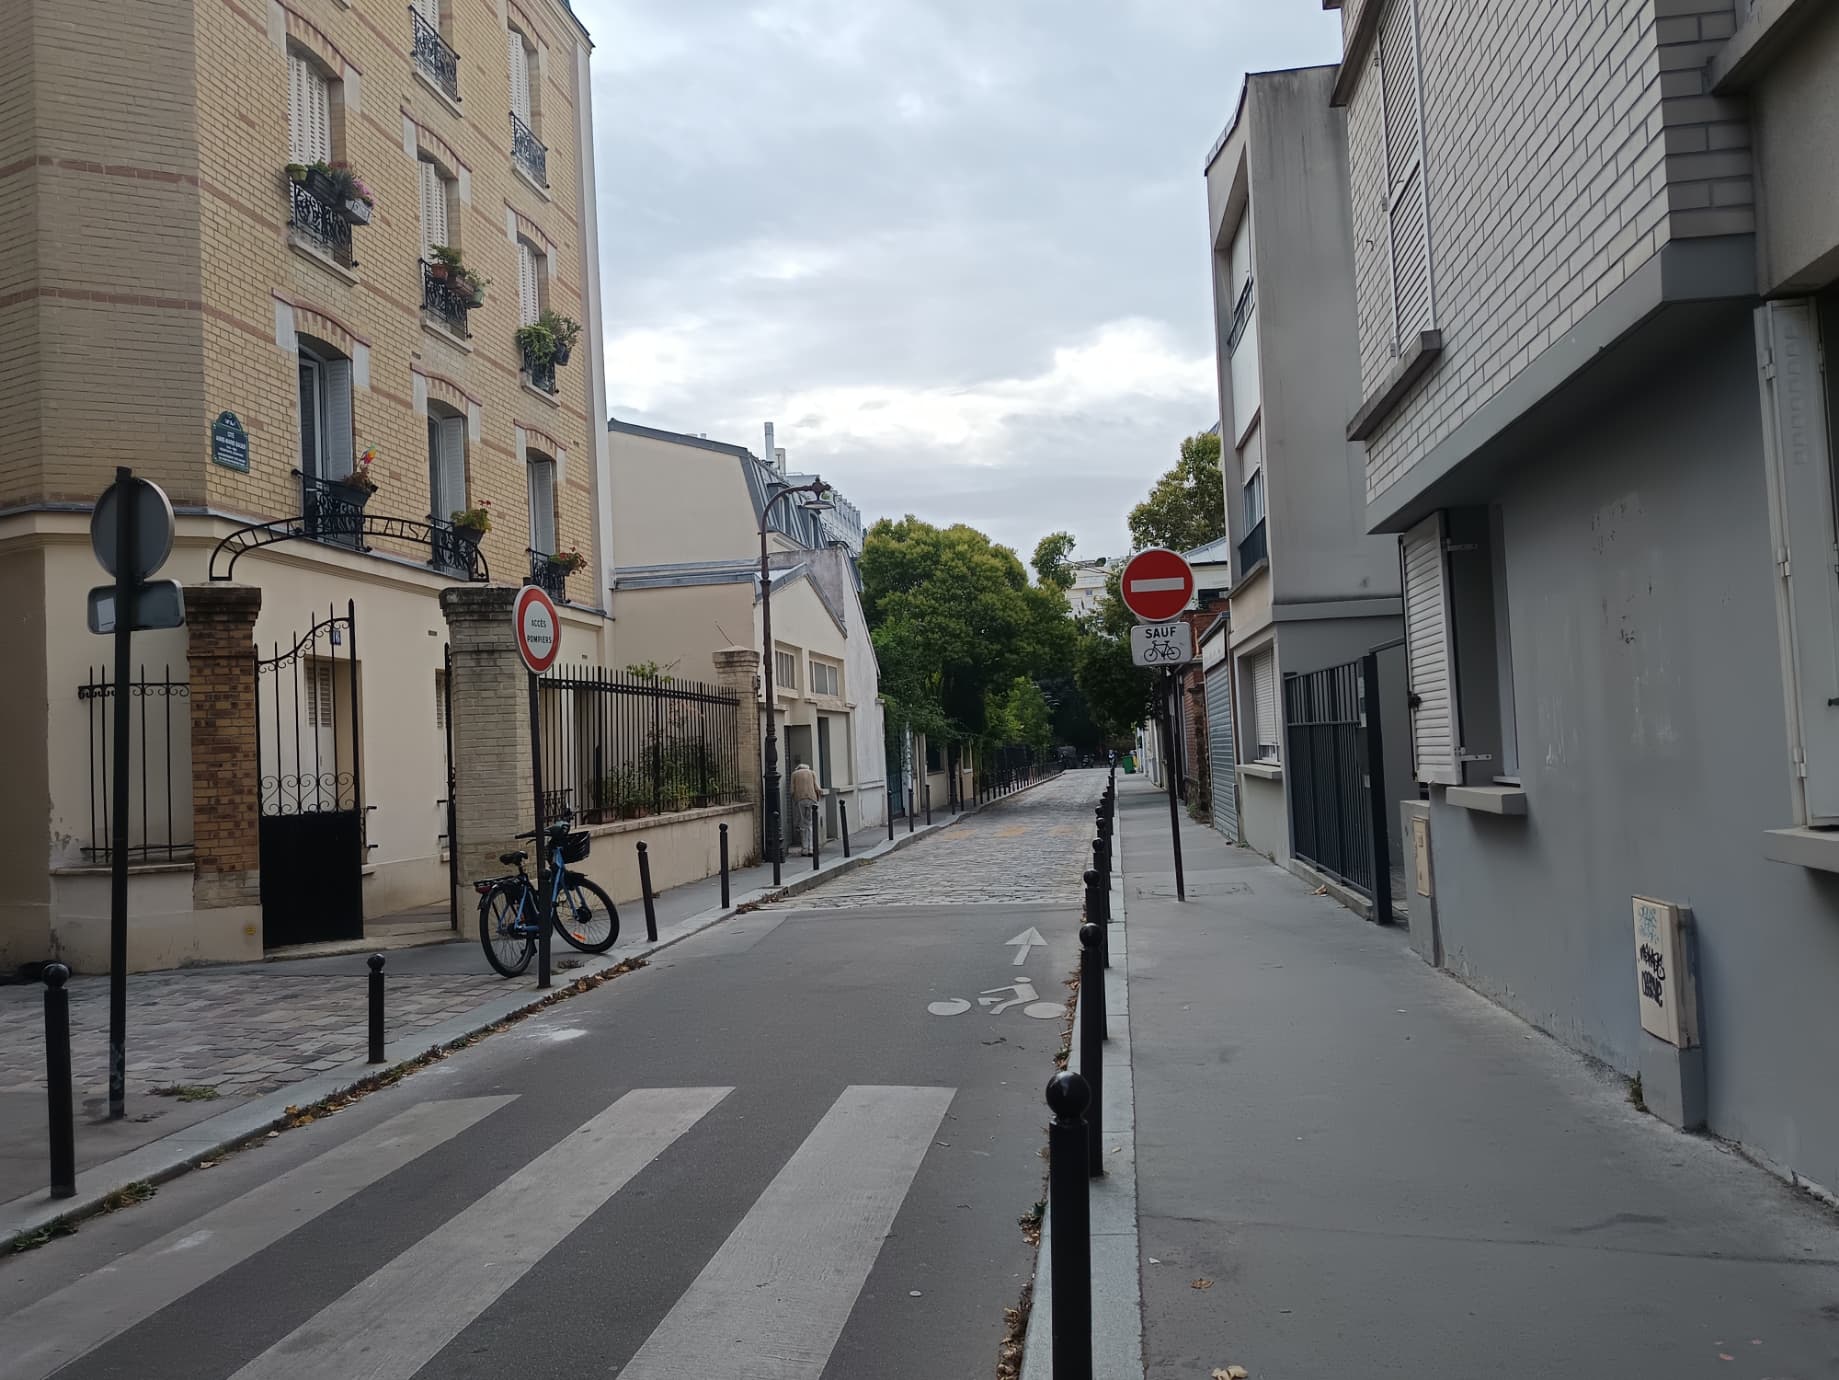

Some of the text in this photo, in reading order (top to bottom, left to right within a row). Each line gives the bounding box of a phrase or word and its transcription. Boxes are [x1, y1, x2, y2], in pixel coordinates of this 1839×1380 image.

[531, 618, 547, 628] ACCÈS
[1145, 626, 1177, 639] SAUF
[527, 634, 552, 644] POMPIERS
